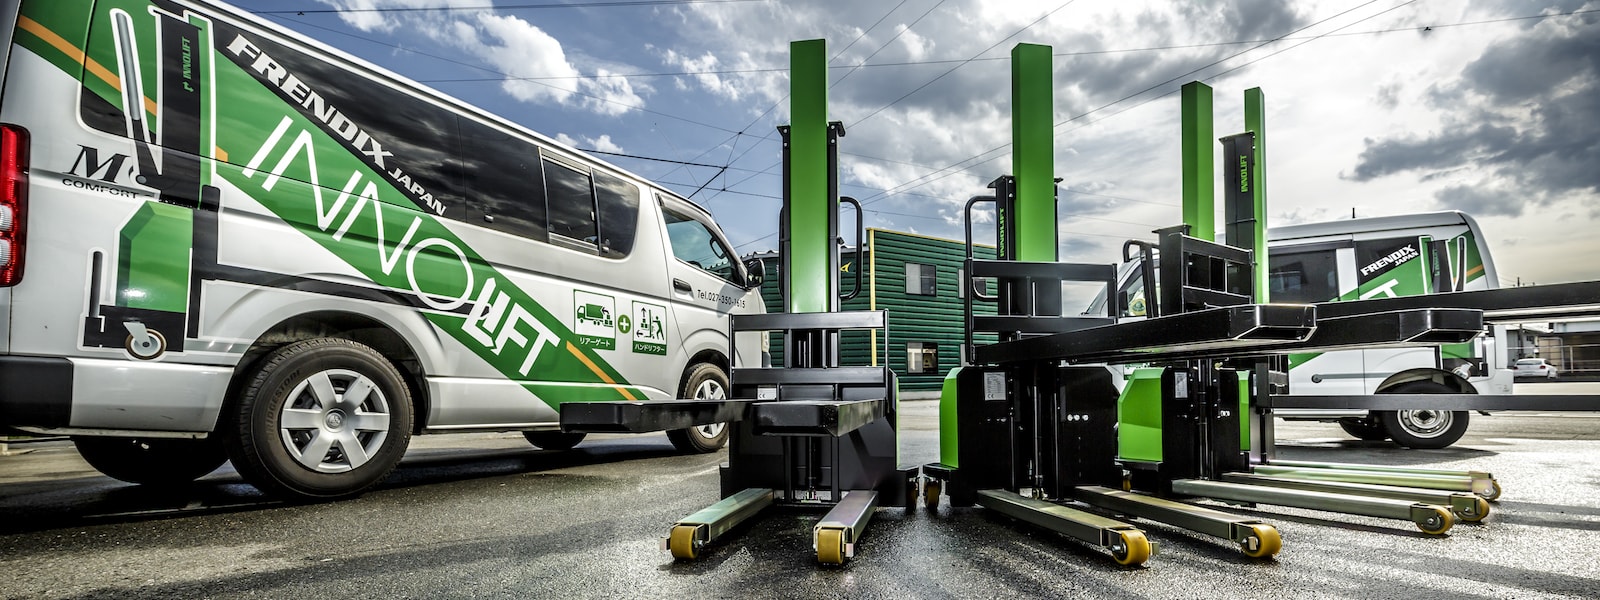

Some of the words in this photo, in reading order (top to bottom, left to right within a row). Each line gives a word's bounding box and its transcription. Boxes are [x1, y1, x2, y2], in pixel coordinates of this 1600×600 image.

[181, 36, 192, 80] INNOLIFT
[226, 33, 394, 171] FRENDIX
[388, 167, 447, 216] JAPAN
[61, 177, 141, 199] COMFORT
[1239, 154, 1249, 193] INNOLIFT
[241, 114, 561, 377] INNOLIFT
[1360, 244, 1416, 276] FRENDIX
[1395, 250, 1419, 267] JAPAN
[579, 336, 611, 347] リアーゲート
[634, 343, 666, 353] ハンドリフター
